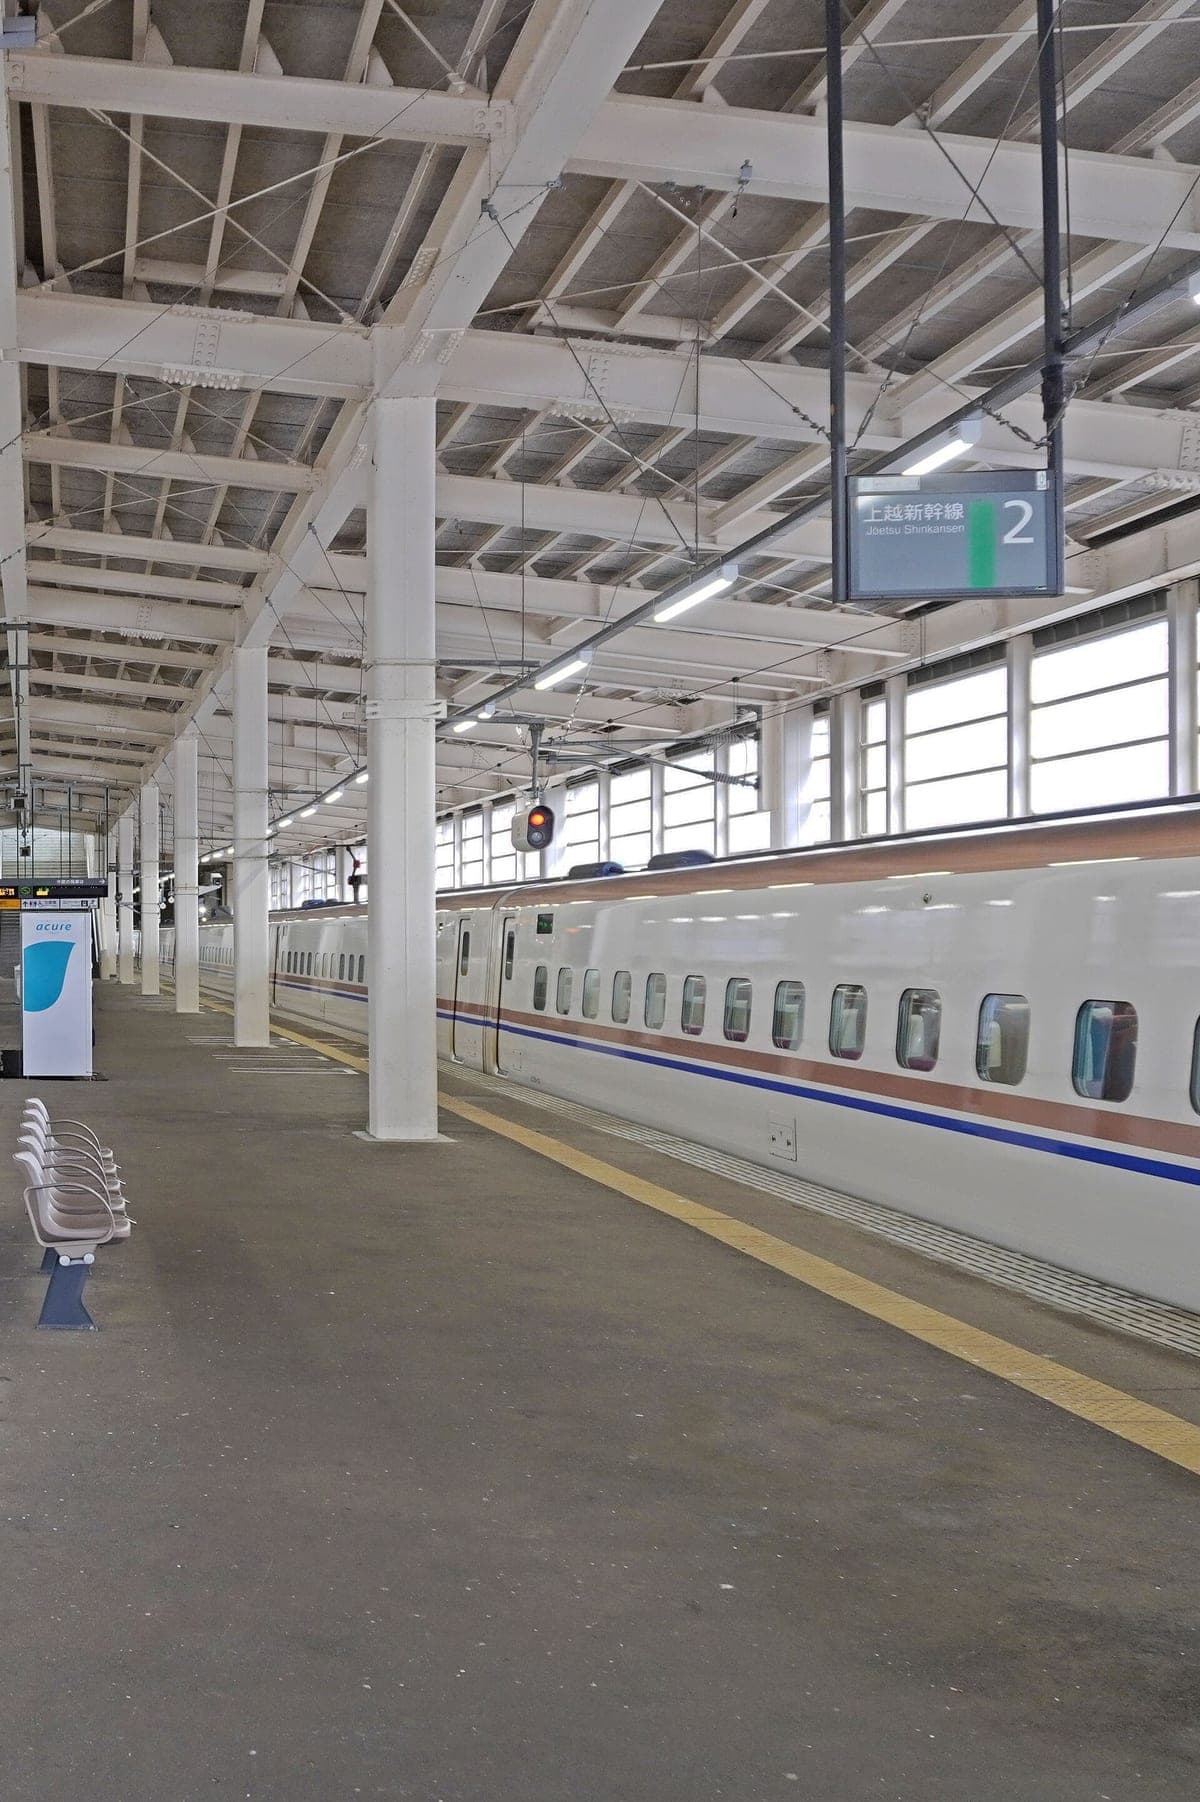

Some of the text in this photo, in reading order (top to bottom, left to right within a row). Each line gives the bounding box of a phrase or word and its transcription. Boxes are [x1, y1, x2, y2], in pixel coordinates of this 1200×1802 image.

[864, 503, 965, 521] 上越新幹線
[1003, 499, 1035, 544] 2
[904, 524, 965, 534] Shinkansen
[36, 923, 72, 931] acure
